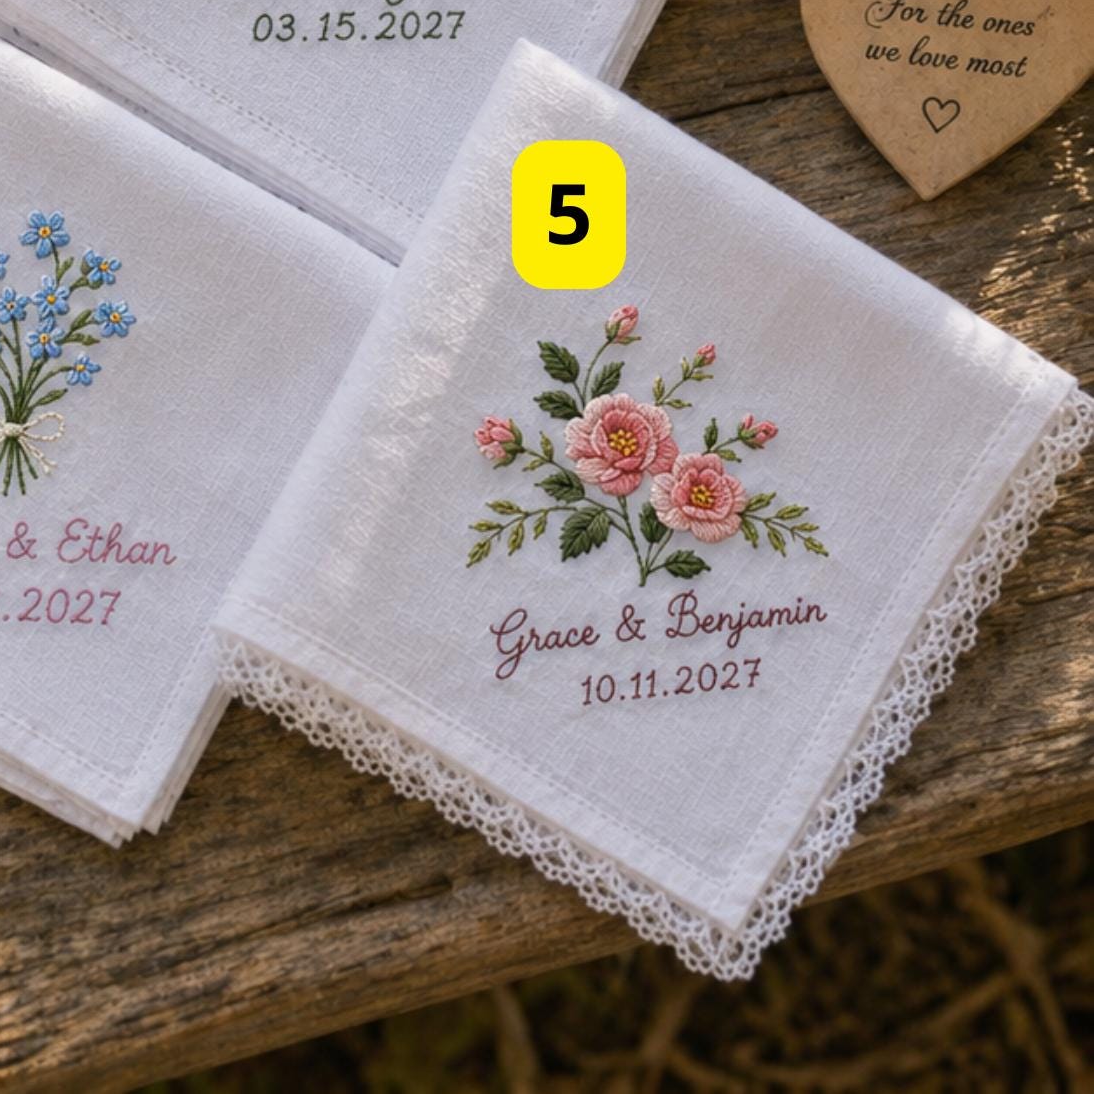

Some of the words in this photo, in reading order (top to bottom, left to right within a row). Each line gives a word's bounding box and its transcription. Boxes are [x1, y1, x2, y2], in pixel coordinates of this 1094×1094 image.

[253, 11, 465, 42] 03.15.2027
[983, 16, 1035, 36] ones
[866, 44, 901, 62] we
[909, 36, 959, 70] love
[966, 56, 1028, 77] most
[6, 522, 37, 560] &
[57, 518, 177, 565] Ethan
[490, 609, 600, 680] Grace
[616, 604, 646, 642] &
[666, 589, 827, 648] Benjamin
[581, 657, 761, 706] 10.11.2027
